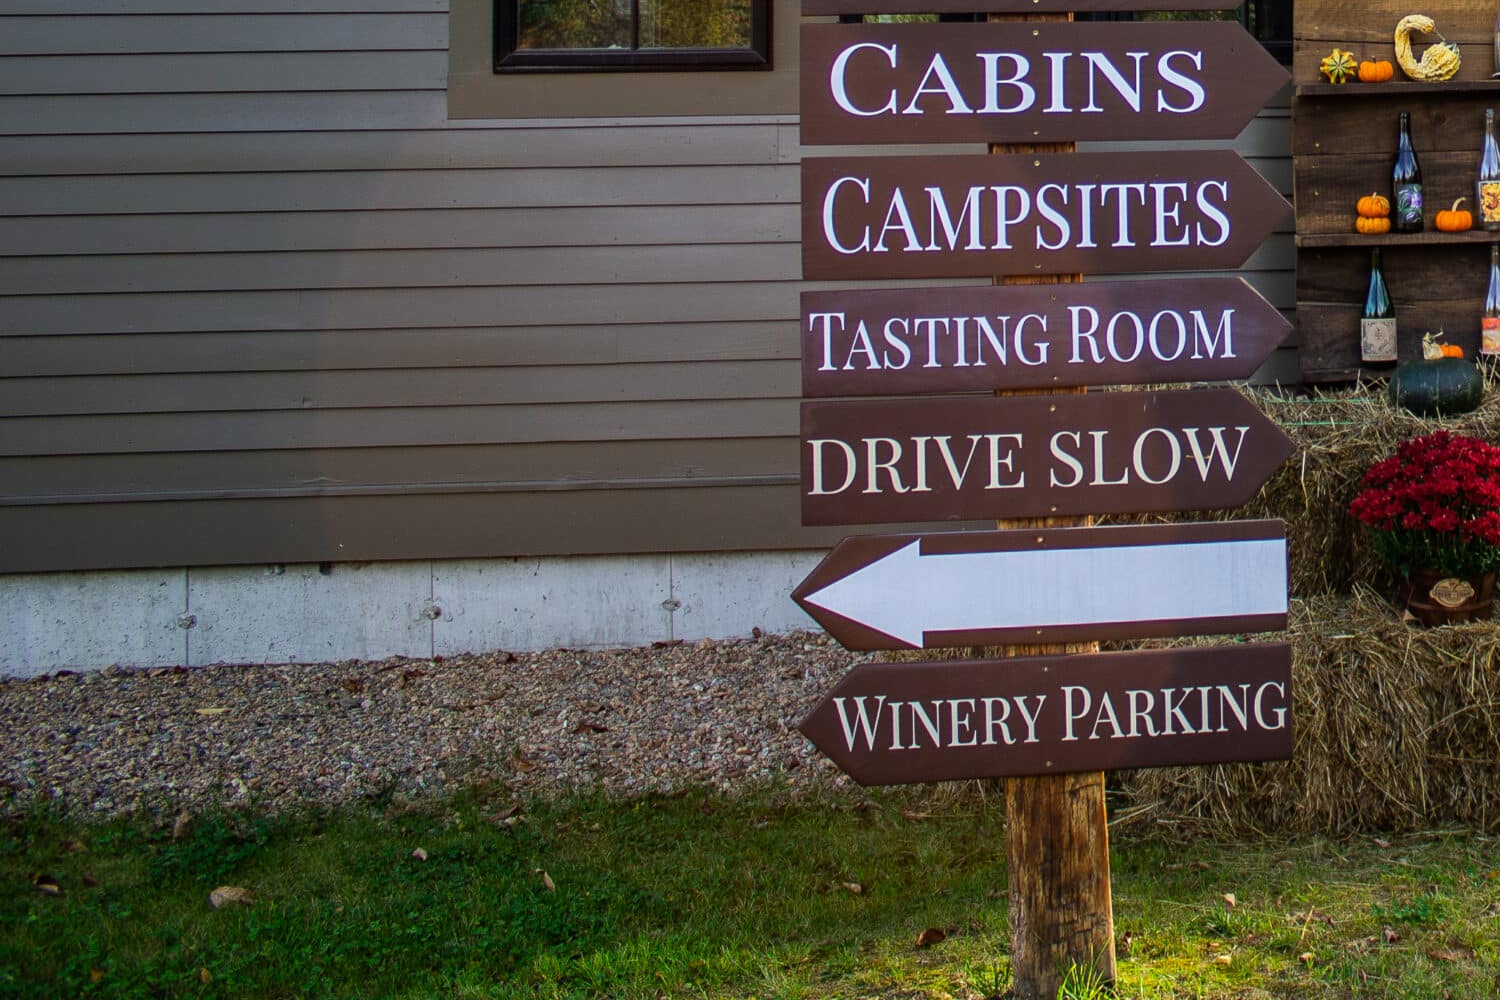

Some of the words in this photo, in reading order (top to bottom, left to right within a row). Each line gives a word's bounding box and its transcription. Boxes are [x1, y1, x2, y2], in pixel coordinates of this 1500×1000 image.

[830, 42, 1205, 116] CABINS
[823, 176, 1230, 254] CAMPSITES
[809, 312, 1050, 372] TASTING
[1066, 305, 1237, 364] ROOM
[807, 433, 1025, 495] DRIVE
[1050, 426, 1250, 488] SLOW
[832, 694, 1047, 753] WINERY
[1060, 681, 1286, 741] PARKING
